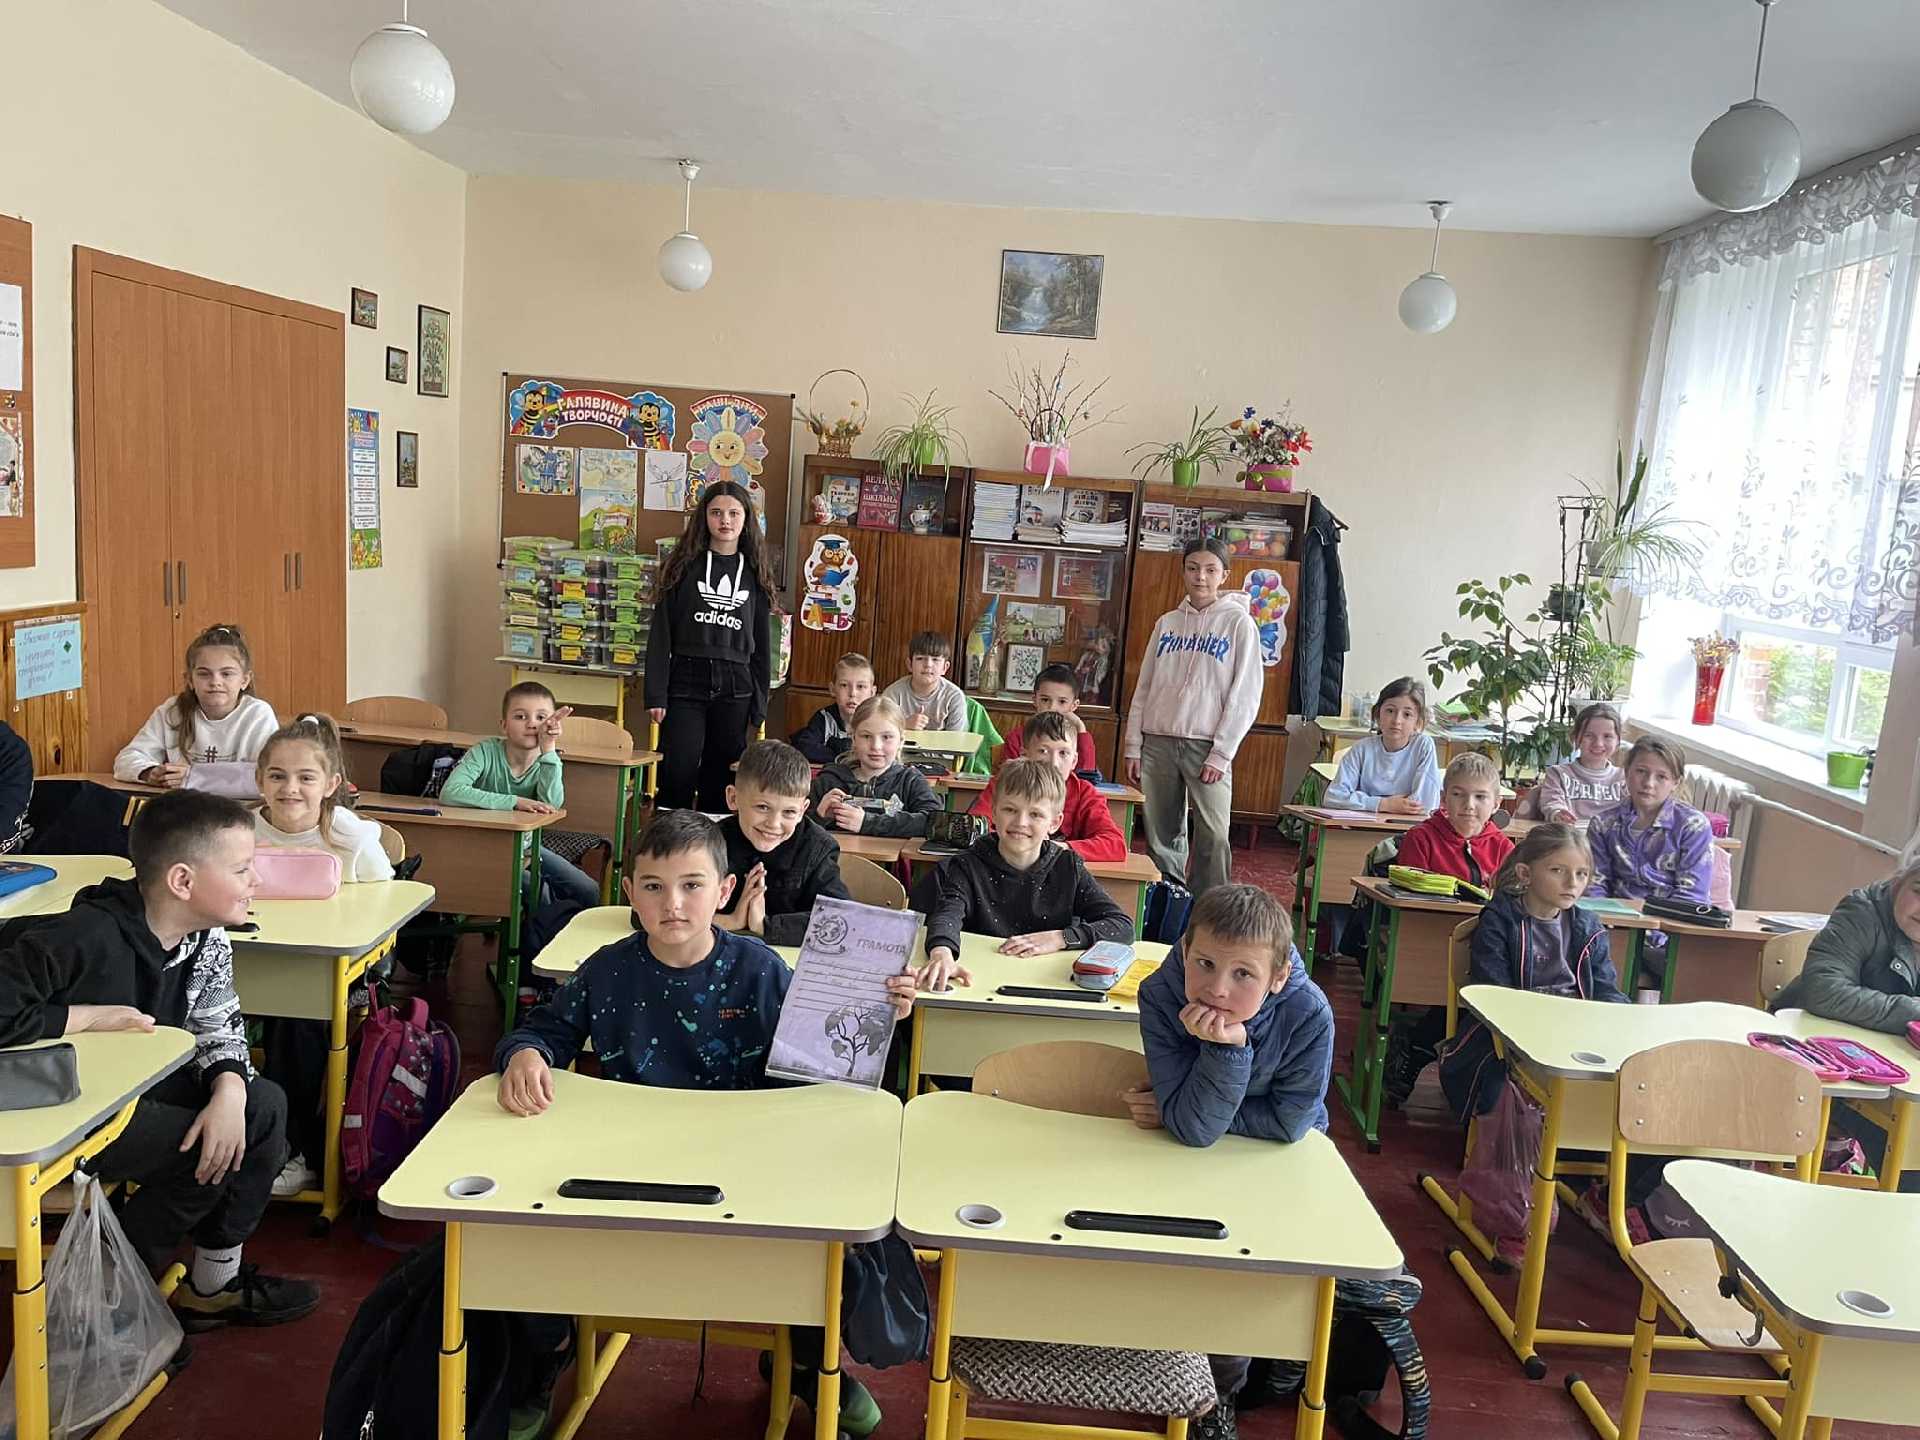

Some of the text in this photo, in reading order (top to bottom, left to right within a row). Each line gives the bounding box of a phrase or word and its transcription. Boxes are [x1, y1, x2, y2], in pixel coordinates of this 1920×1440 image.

[557, 396, 628, 418] ГАЛЯВИНА
[561, 410, 624, 428] ТВОРЧОСТІ
[694, 610, 743, 630] adidas
[1157, 630, 1230, 663] THRASHER
[856, 938, 906, 954] ГРАМОТА
